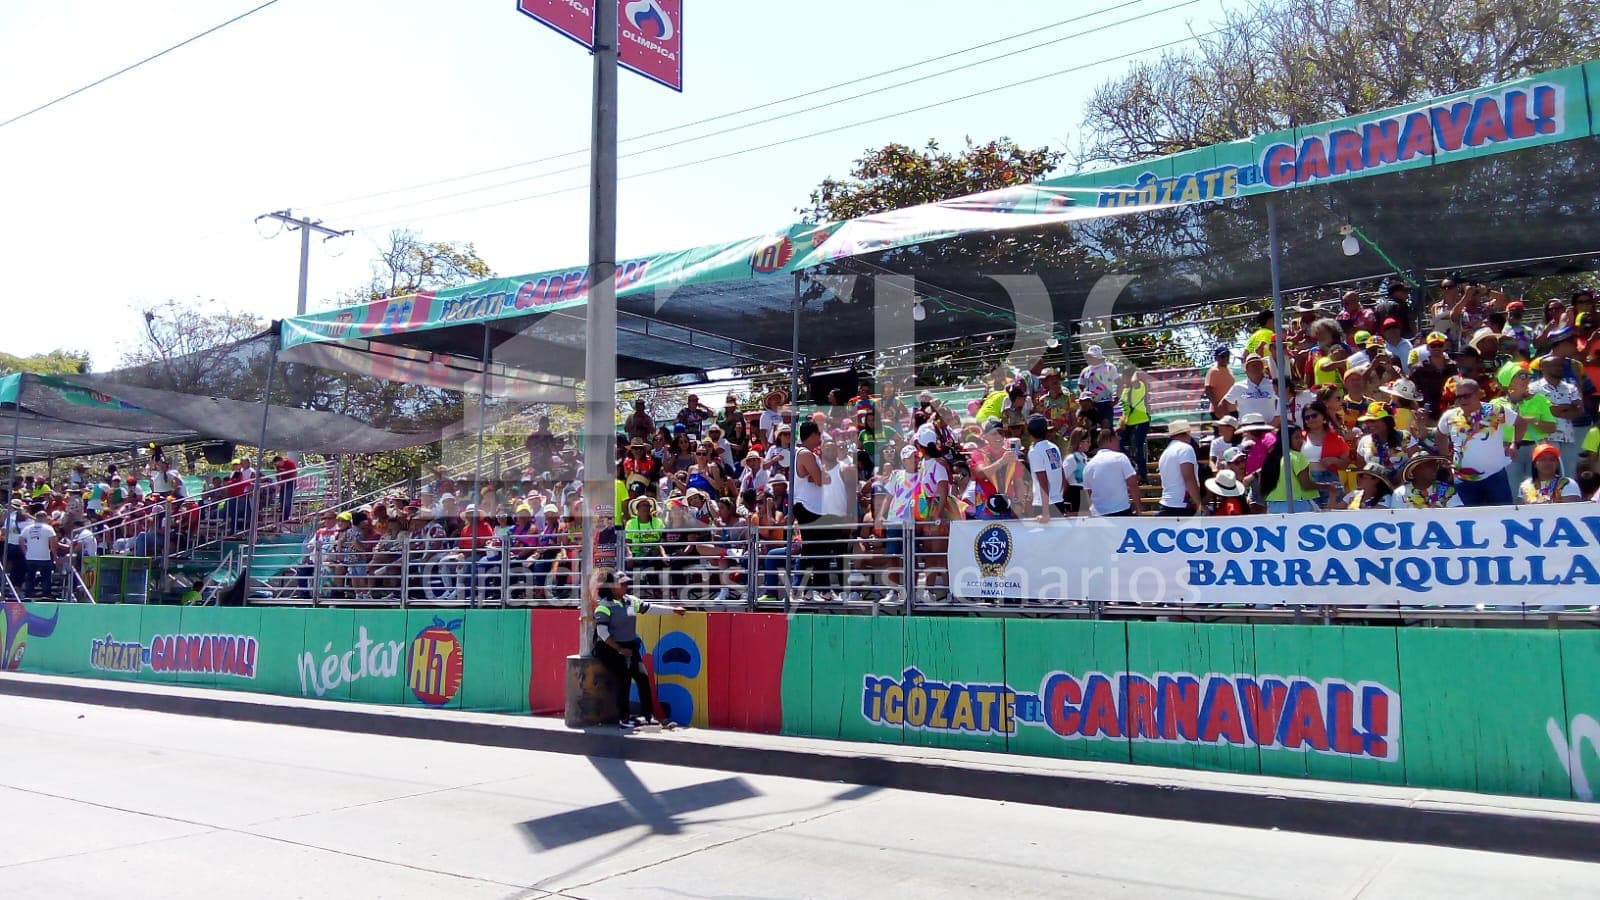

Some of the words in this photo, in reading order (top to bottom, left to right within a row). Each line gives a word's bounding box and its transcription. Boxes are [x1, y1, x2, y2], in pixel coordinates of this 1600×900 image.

[622, 29, 676, 61] OLIMPICA
[1263, 85, 1556, 187] CARNAVAL!
[1116, 526, 1285, 554] ACCION
[1298, 519, 1489, 551] SOCIAL
[1187, 554, 1600, 592] BARRANQUILLA
[151, 635, 257, 677] CARNAVAL!
[298, 626, 404, 695] néctar
[1044, 673, 1397, 759] CARNAVAL!
